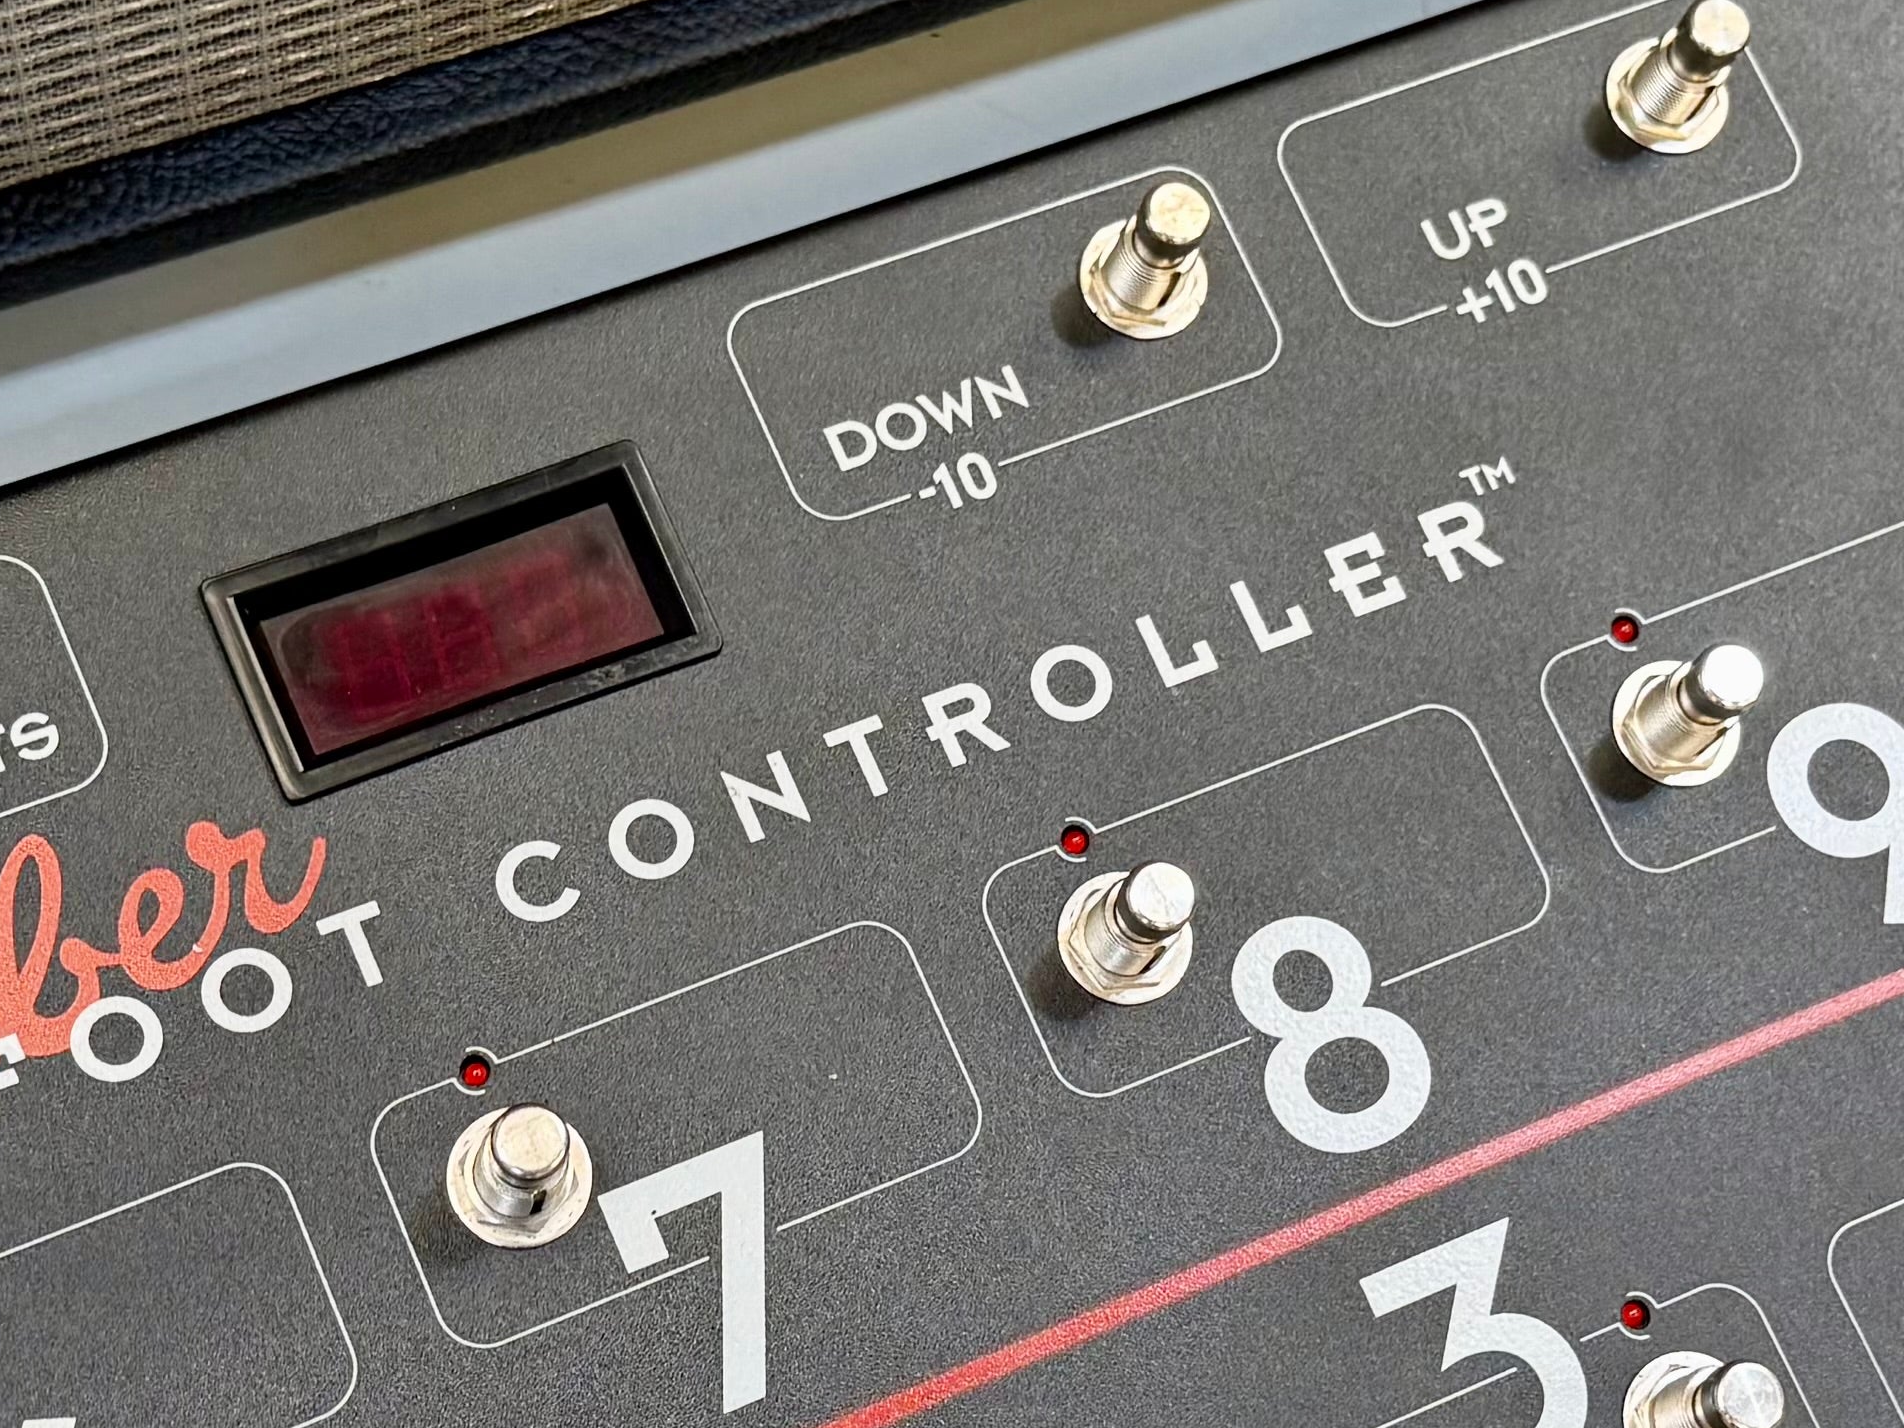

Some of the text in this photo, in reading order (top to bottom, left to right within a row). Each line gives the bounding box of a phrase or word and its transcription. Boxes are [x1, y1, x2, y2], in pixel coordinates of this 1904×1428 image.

[1420, 196, 1509, 260] UP
[1455, 255, 1550, 324] +10
[821, 363, 1031, 472] DOWN
[917, 451, 998, 510] -10
[1230, 915, 1434, 1154] 8
[596, 1129, 767, 1416] 7
